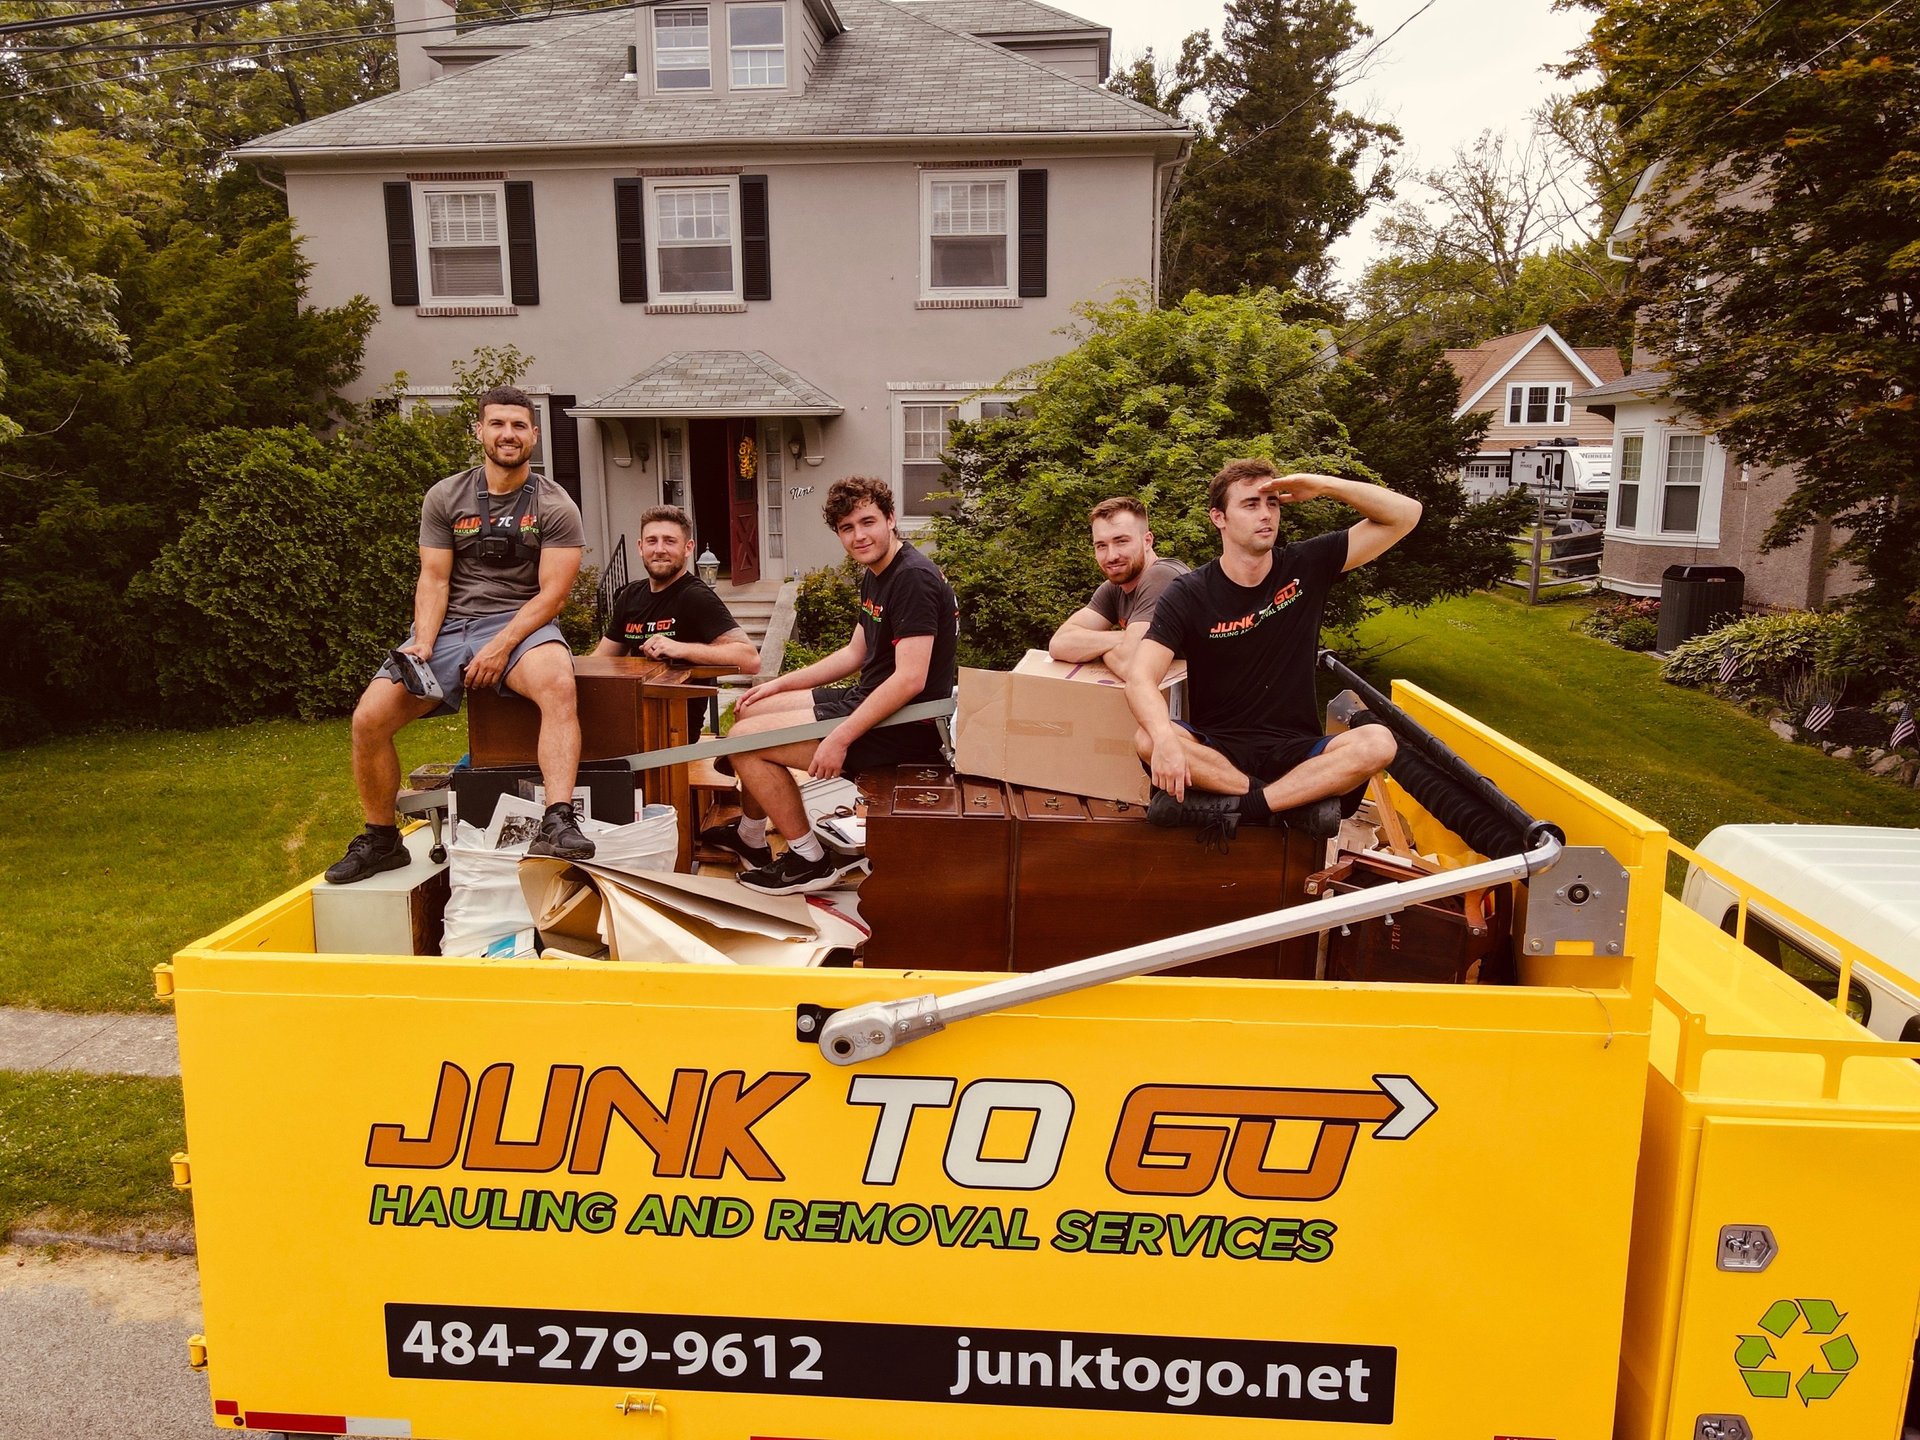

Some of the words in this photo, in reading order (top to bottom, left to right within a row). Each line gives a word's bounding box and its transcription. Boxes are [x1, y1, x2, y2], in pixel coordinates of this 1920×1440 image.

[1209, 631, 1239, 639] HAULING
[1210, 613, 1256, 634] JUNK
[365, 1061, 811, 1181] JUNK
[846, 1074, 1075, 1191] TO
[1105, 1083, 1405, 1202] GO
[369, 1185, 618, 1233] HAULING
[625, 1194, 754, 1238] AND
[764, 1199, 1040, 1251] REMOVAL
[1051, 1209, 1338, 1263] SERVICES
[402, 1320, 823, 1380] 484-279-9612
[950, 1336, 1371, 1406] junktogo.net
